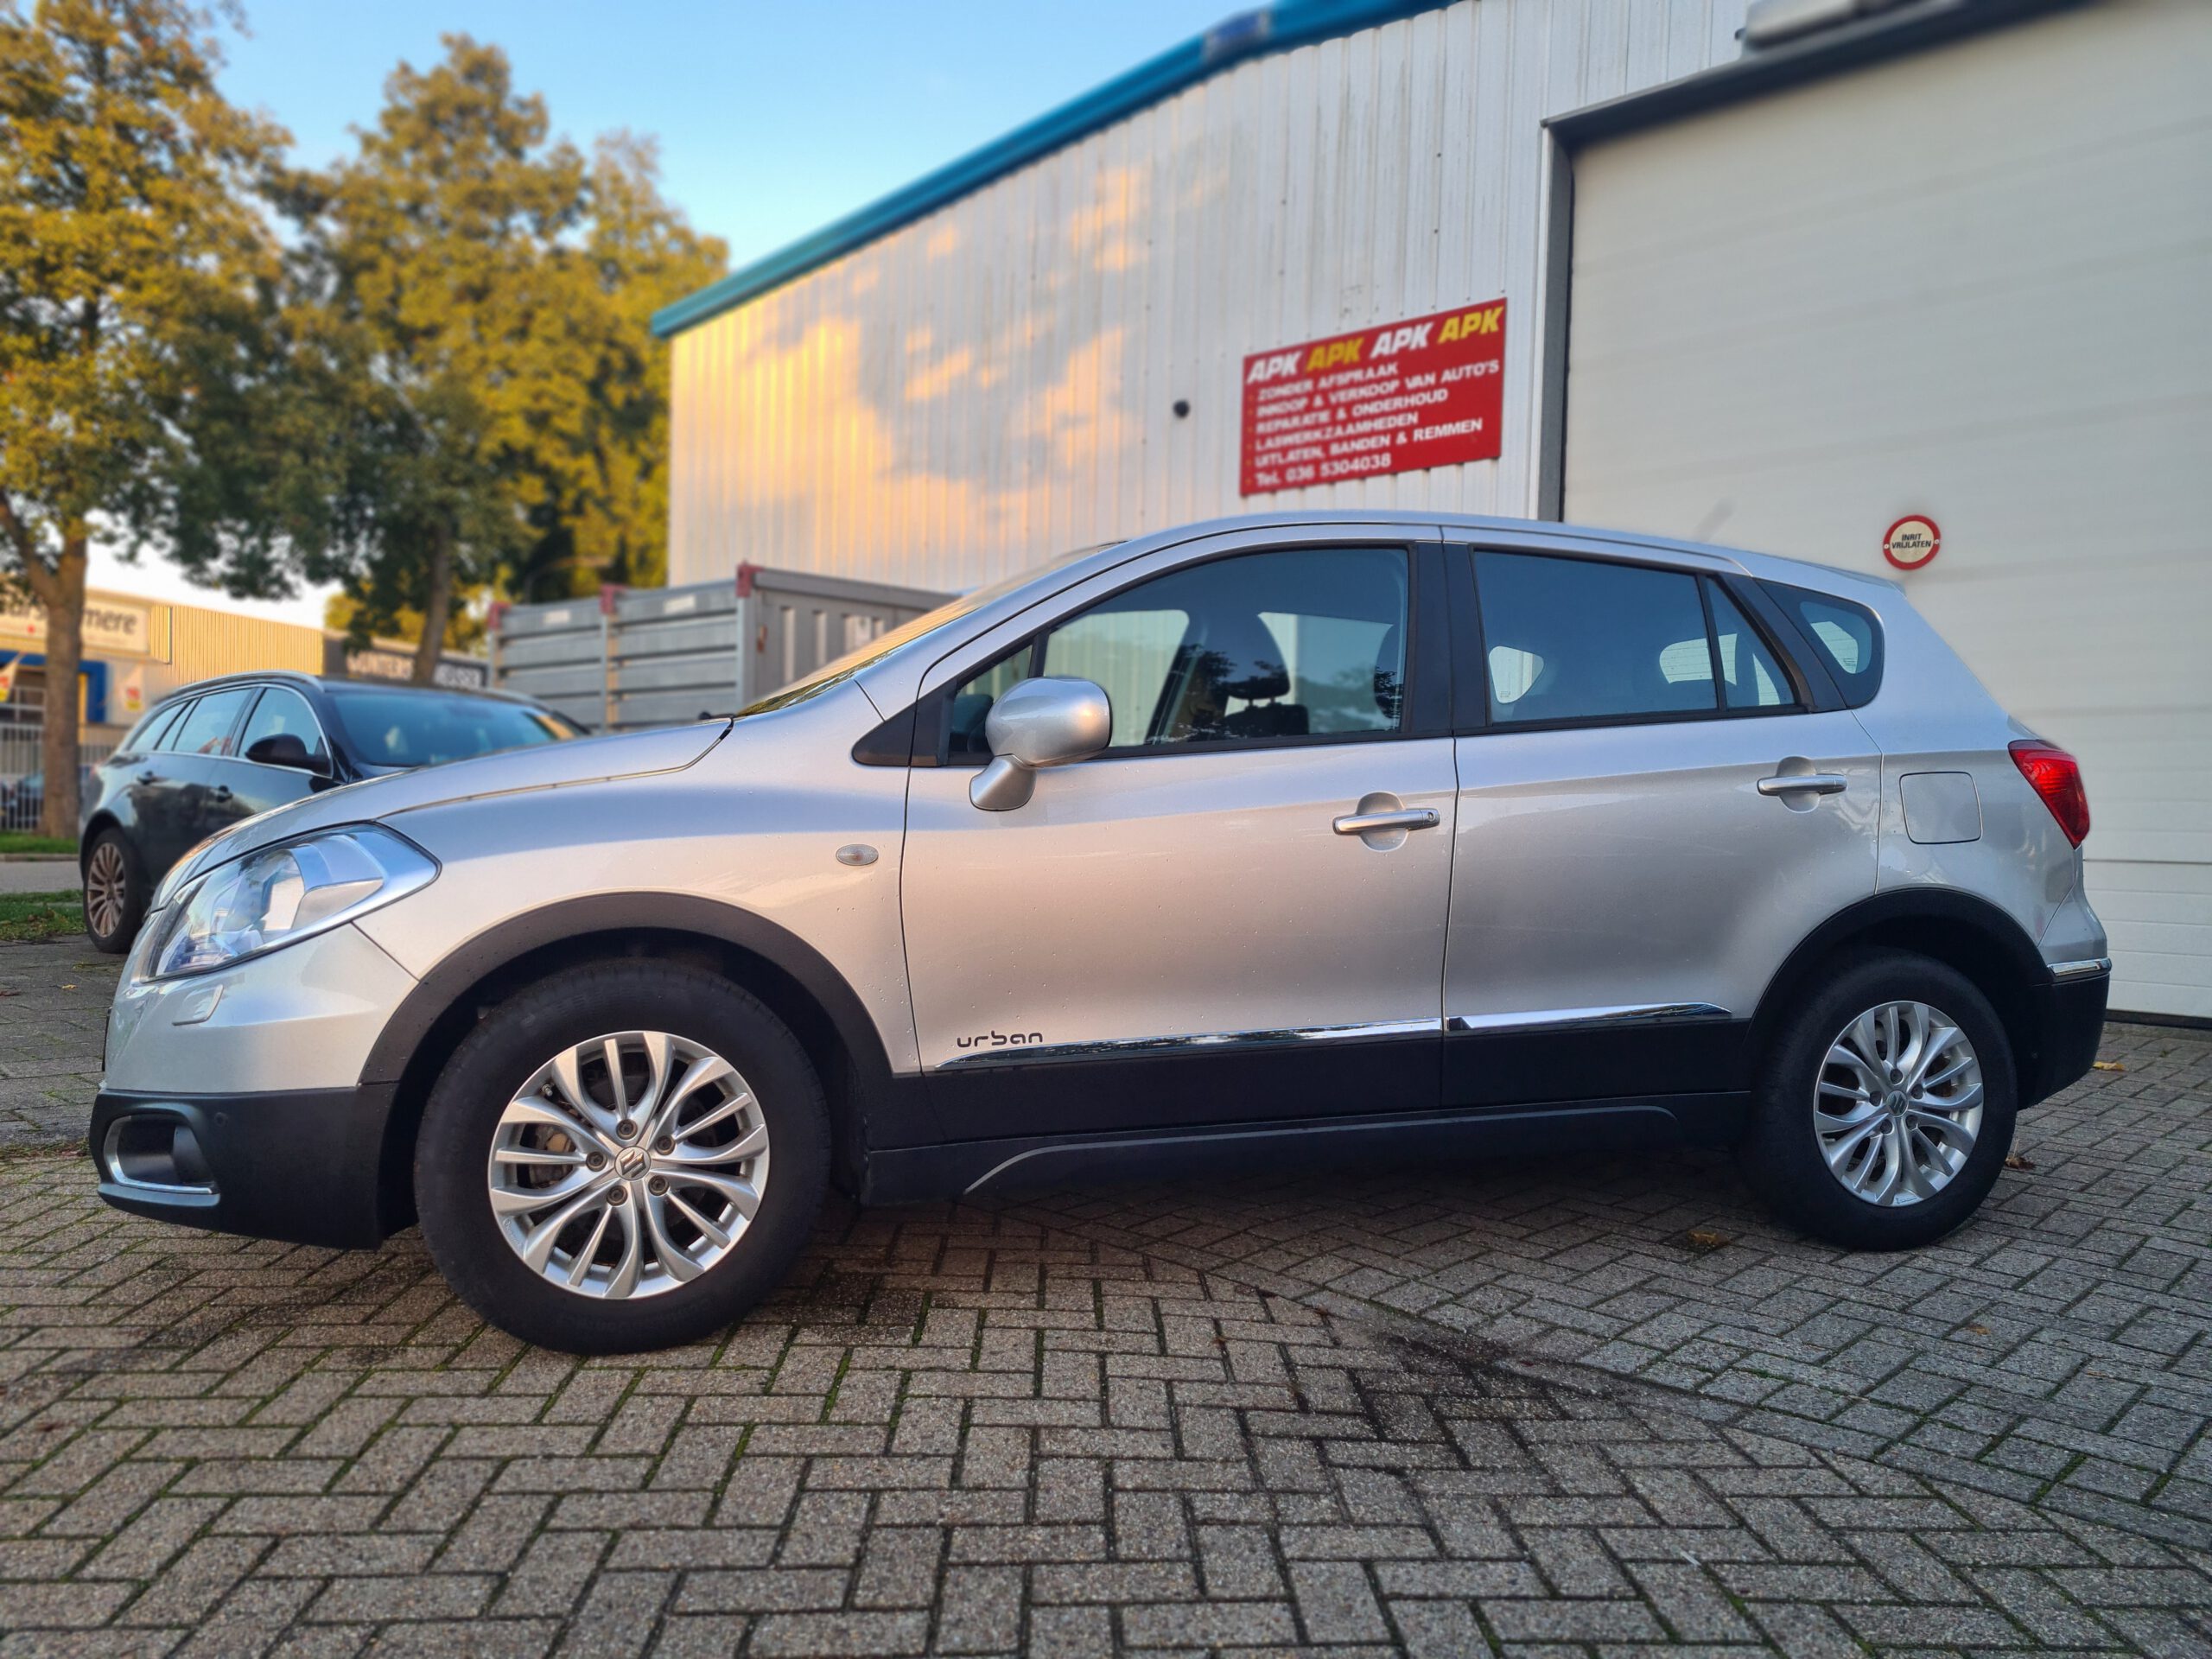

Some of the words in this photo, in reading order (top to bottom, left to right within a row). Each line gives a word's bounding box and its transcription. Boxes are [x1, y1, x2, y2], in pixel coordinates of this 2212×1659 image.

[1247, 350, 1303, 384] APK
[1306, 337, 1364, 373] APK
[1370, 321, 1434, 359] APK
[1437, 306, 1503, 344] APK
[1257, 397, 1309, 417] INKOOP
[1313, 394, 1324, 408] &
[1328, 379, 1400, 404] VERKOOP
[1405, 372, 1436, 389] VAN
[1440, 359, 1499, 384] AUTO'S
[1258, 379, 1314, 401] ZONDER
[1318, 362, 1398, 389] AFSPRAAK
[1255, 411, 1419, 452] LASWERKZAAMHEDEN
[1256, 410, 1331, 434] REPARATIE
[1336, 407, 1347, 421] &
[1351, 390, 1448, 417] ONDERHOUD
[1330, 434, 1390, 456] BANDEN
[1395, 431, 1408, 446] &
[1413, 417, 1483, 442] REMMEN
[1286, 465, 1315, 483] 036
[1320, 453, 1391, 477] 5304038
[84, 607, 137, 635] mere
[957, 1030, 1044, 1048] urban
